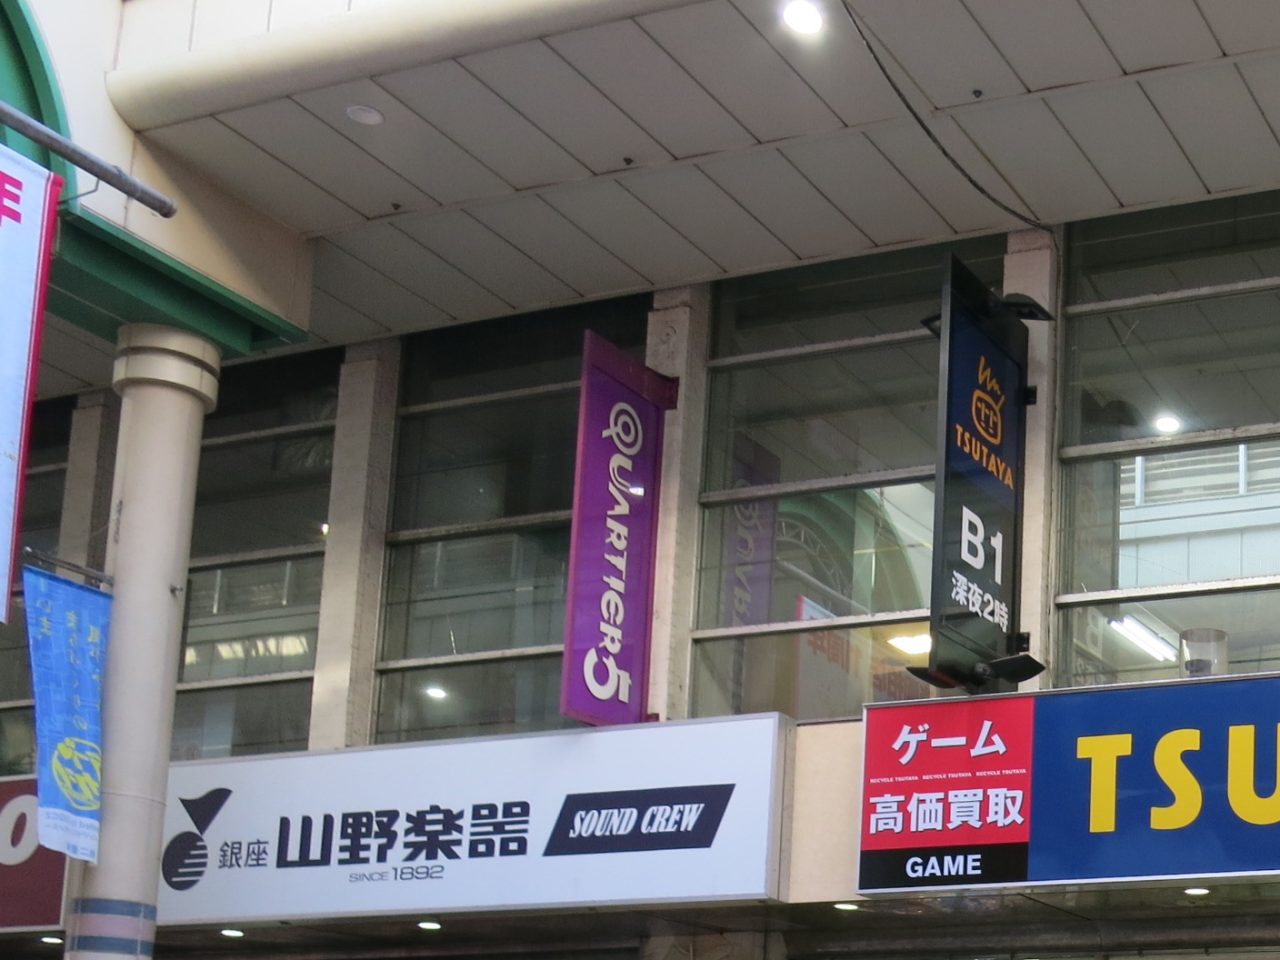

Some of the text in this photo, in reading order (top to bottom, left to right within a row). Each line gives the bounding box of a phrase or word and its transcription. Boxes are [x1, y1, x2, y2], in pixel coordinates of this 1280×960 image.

[955, 423, 1014, 491] TSUTAYA
[961, 506, 1004, 586] B1
[951, 570, 1009, 633] 深夜2時
[892, 720, 1007, 765] ゲーム
[569, 802, 705, 838] SOUND CREW
[869, 788, 1024, 834] 高価買取
[217, 801, 530, 870] 銀座 山野楽器
[348, 865, 444, 884] SINCE 1892
[906, 854, 982, 878] GAME
